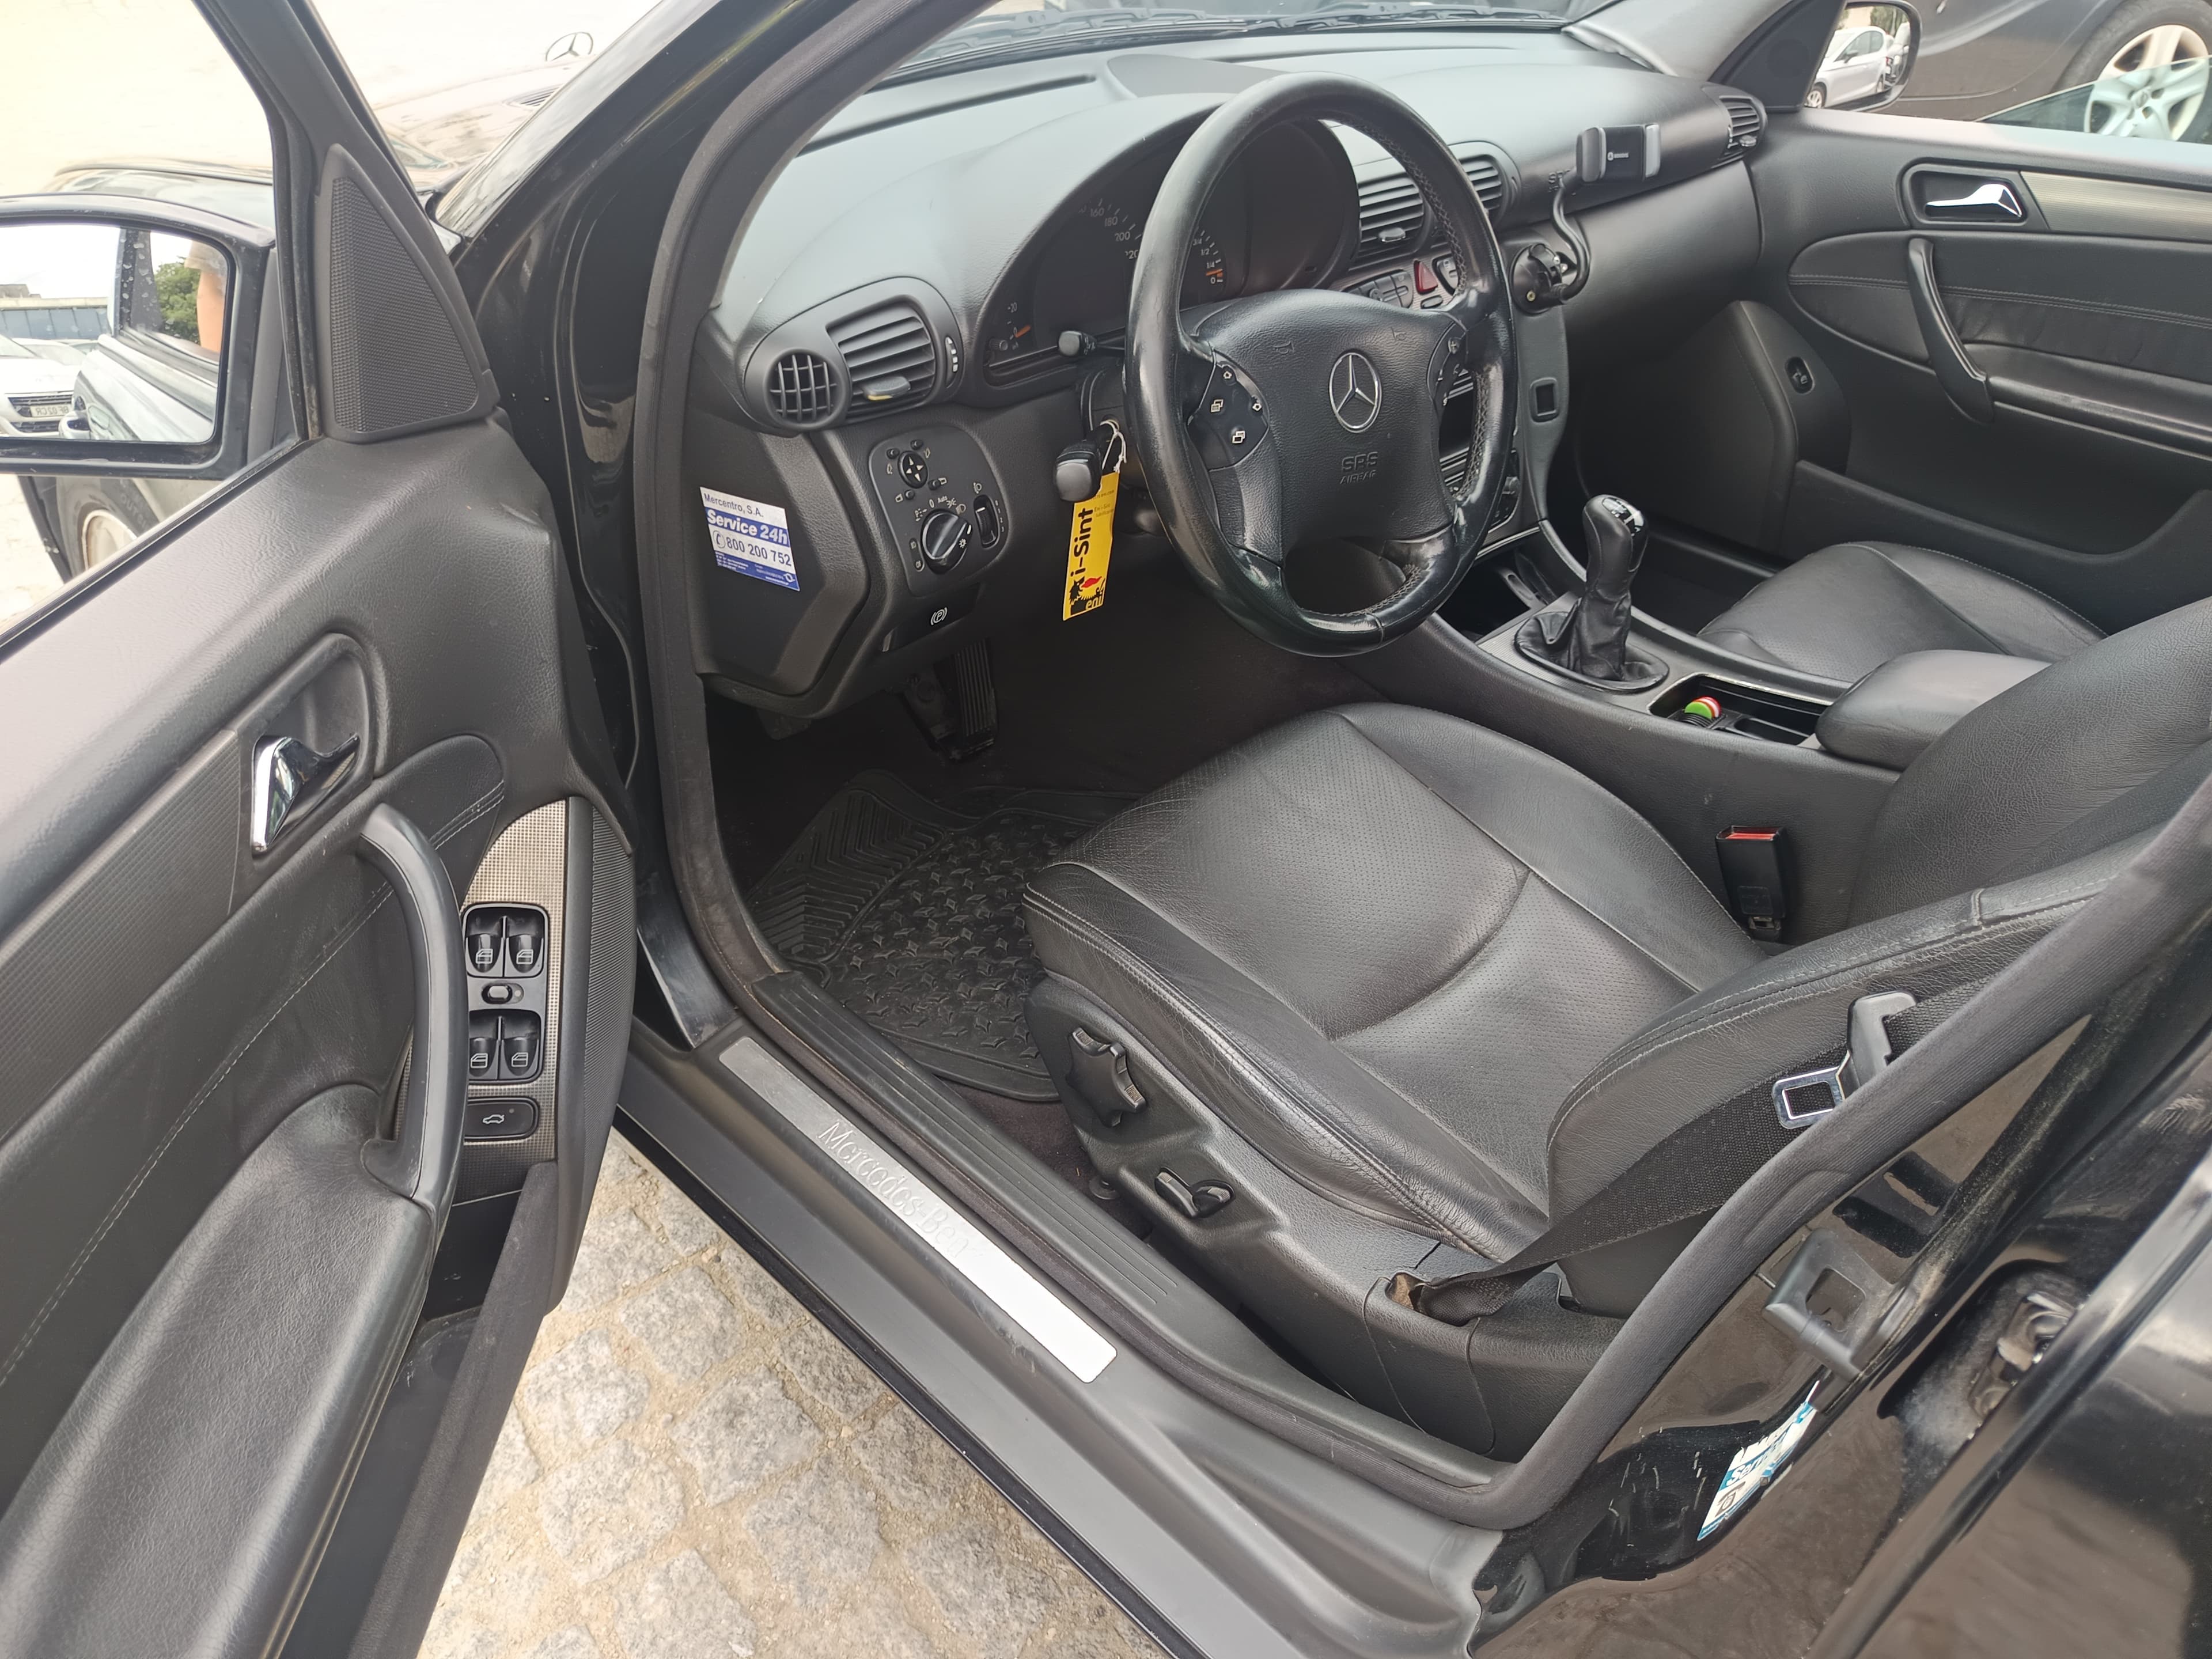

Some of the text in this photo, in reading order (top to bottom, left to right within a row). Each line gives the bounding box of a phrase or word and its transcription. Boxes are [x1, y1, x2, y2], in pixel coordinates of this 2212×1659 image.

[1115, 231, 1130, 241] 200
[704, 493, 764, 517] Mercentro, S.A.
[937, 495, 948, 504] Auto
[707, 509, 788, 545] Service 24h
[726, 537, 791, 567] 800 200 752
[1070, 507, 1093, 577] i-Sint
[1085, 590, 1103, 610] eni
[816, 1119, 980, 1259] Mercedes-Ben
